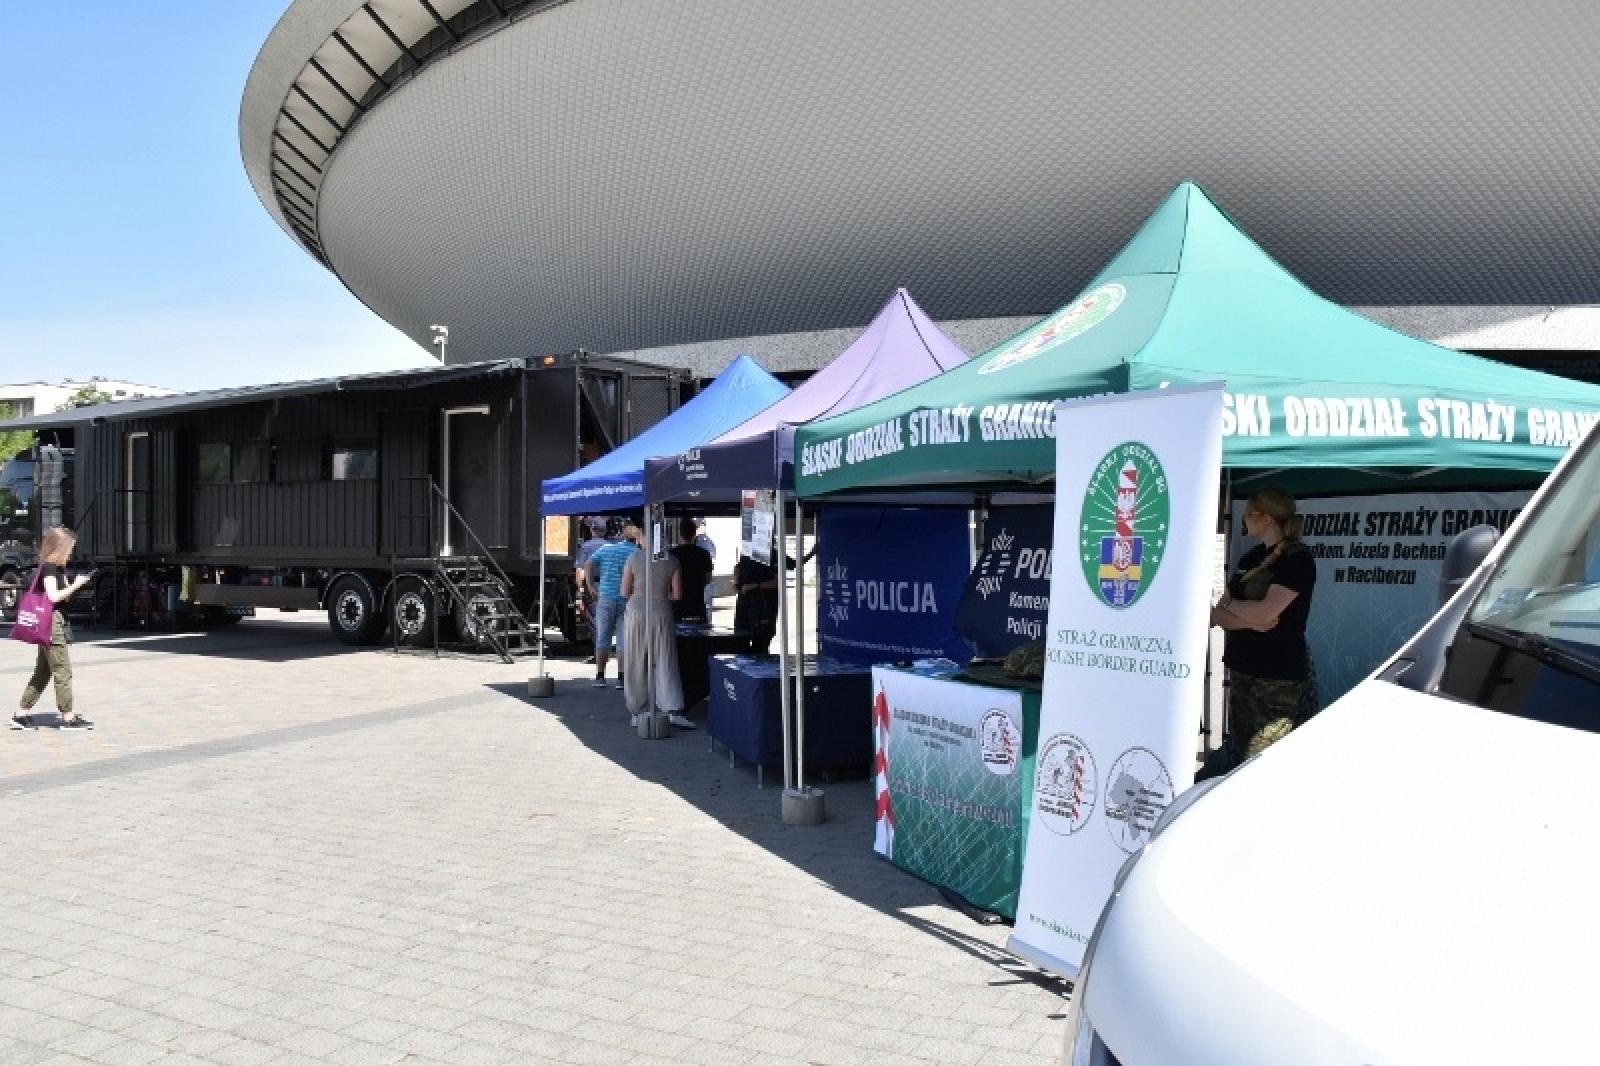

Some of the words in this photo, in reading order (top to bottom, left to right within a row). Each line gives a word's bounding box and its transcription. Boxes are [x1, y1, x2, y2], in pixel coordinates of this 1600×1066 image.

[1223, 392, 1270, 437] SKI
[1284, 395, 1409, 437] ODDZIAŁ
[1416, 397, 1517, 443] STRAŻY
[801, 437, 843, 478] ŚLĄSKI
[845, 418, 905, 465] ODDZIAŁ
[909, 403, 975, 447] STRAŻY
[979, 401, 1056, 441] GRANIC
[1364, 505, 1439, 537] STRAŻY
[1014, 547, 1053, 580] POL
[1348, 541, 1390, 559] Józefa
[1392, 541, 1447, 560] Bocheń
[1334, 567, 1345, 583] w
[1347, 565, 1417, 585] Raciborzu
[855, 579, 938, 614] POLICJA
[1008, 591, 1050, 611] Komen
[1007, 615, 1042, 641] Policji
[1057, 629, 1097, 647] STRAŻ
[1099, 632, 1173, 655] GRANICZNA
[1087, 653, 1137, 673] BORDER
[1139, 658, 1191, 679] GUARD
